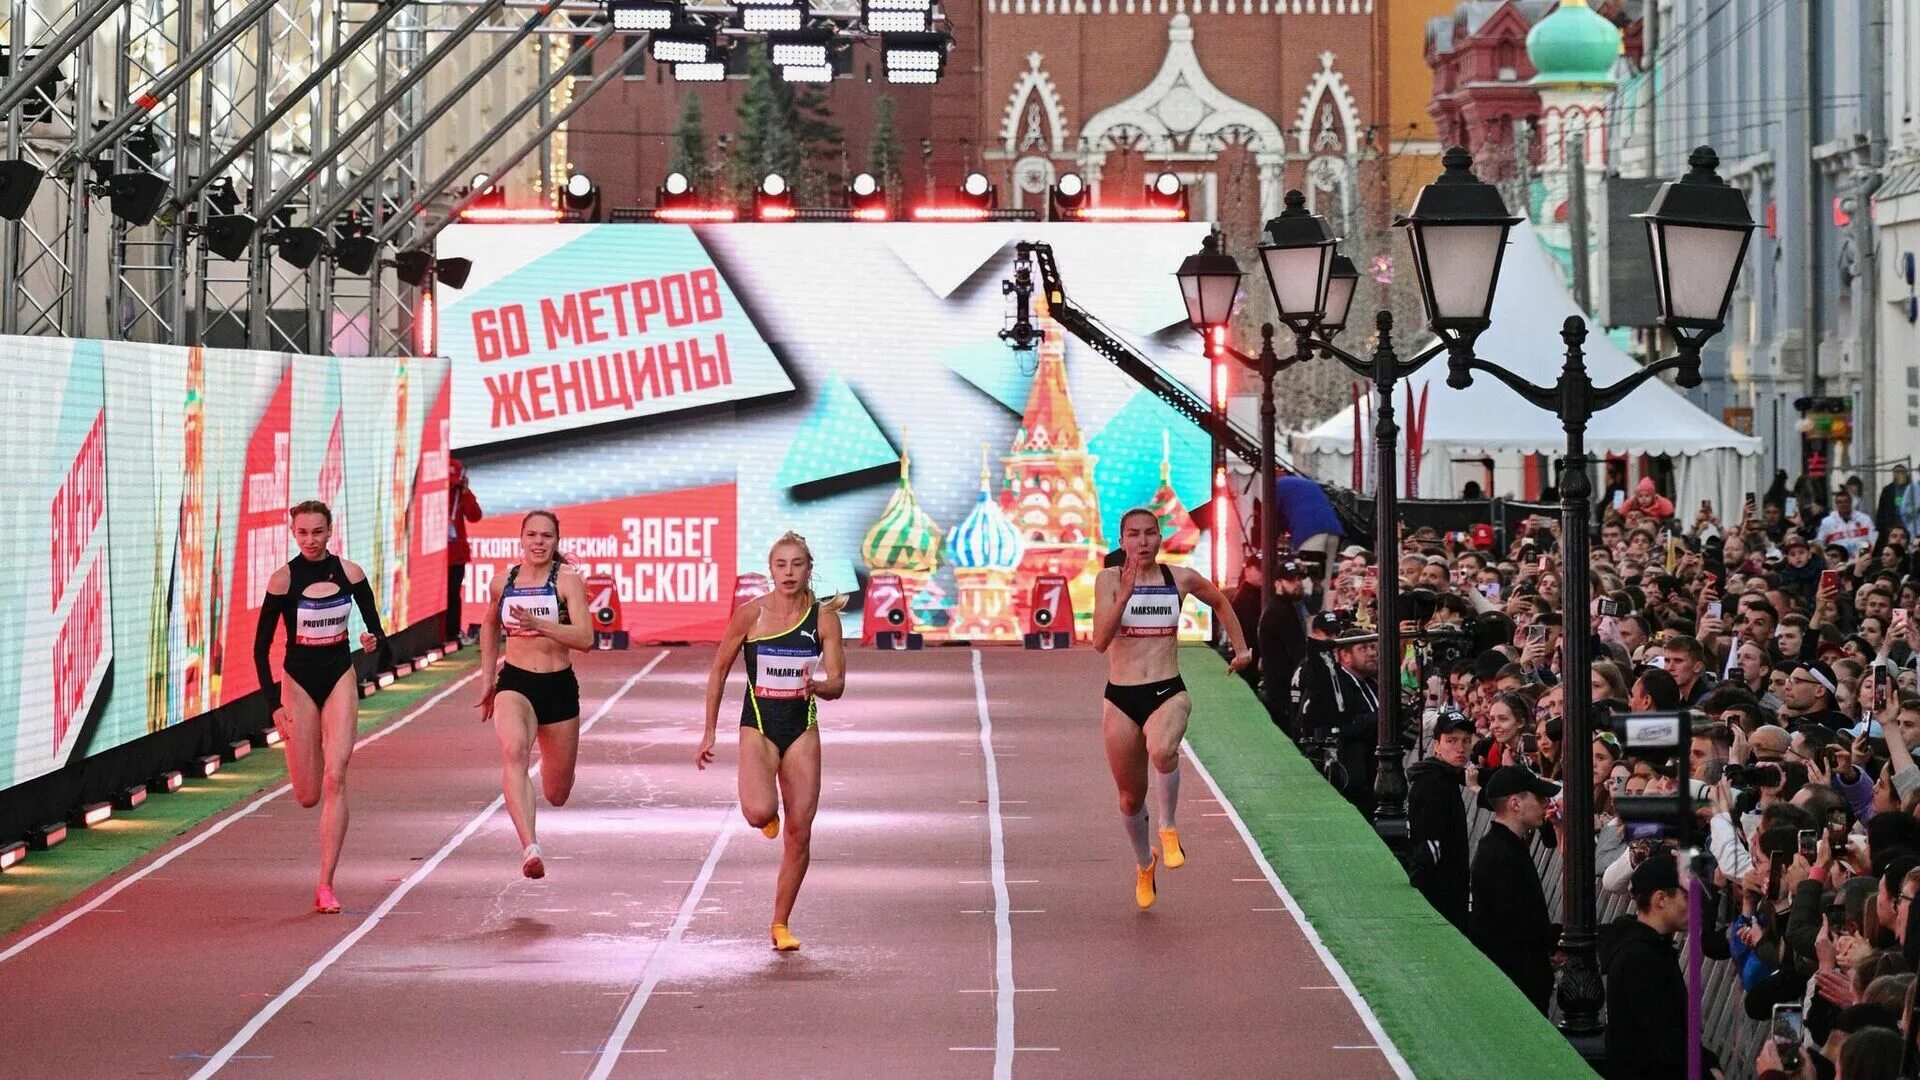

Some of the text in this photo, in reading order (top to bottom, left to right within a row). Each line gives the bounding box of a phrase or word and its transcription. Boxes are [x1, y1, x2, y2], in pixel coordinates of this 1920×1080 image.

[471, 268, 723, 363] 60 МЕТРОВ
[484, 333, 733, 428] ЖЕНЩИНЫ
[622, 517, 719, 557] ЗАБЕГ
[588, 586, 612, 613] 4
[872, 585, 900, 618] 2
[1043, 586, 1061, 620] 1
[1131, 606, 1172, 616] MAKSIMOVA
